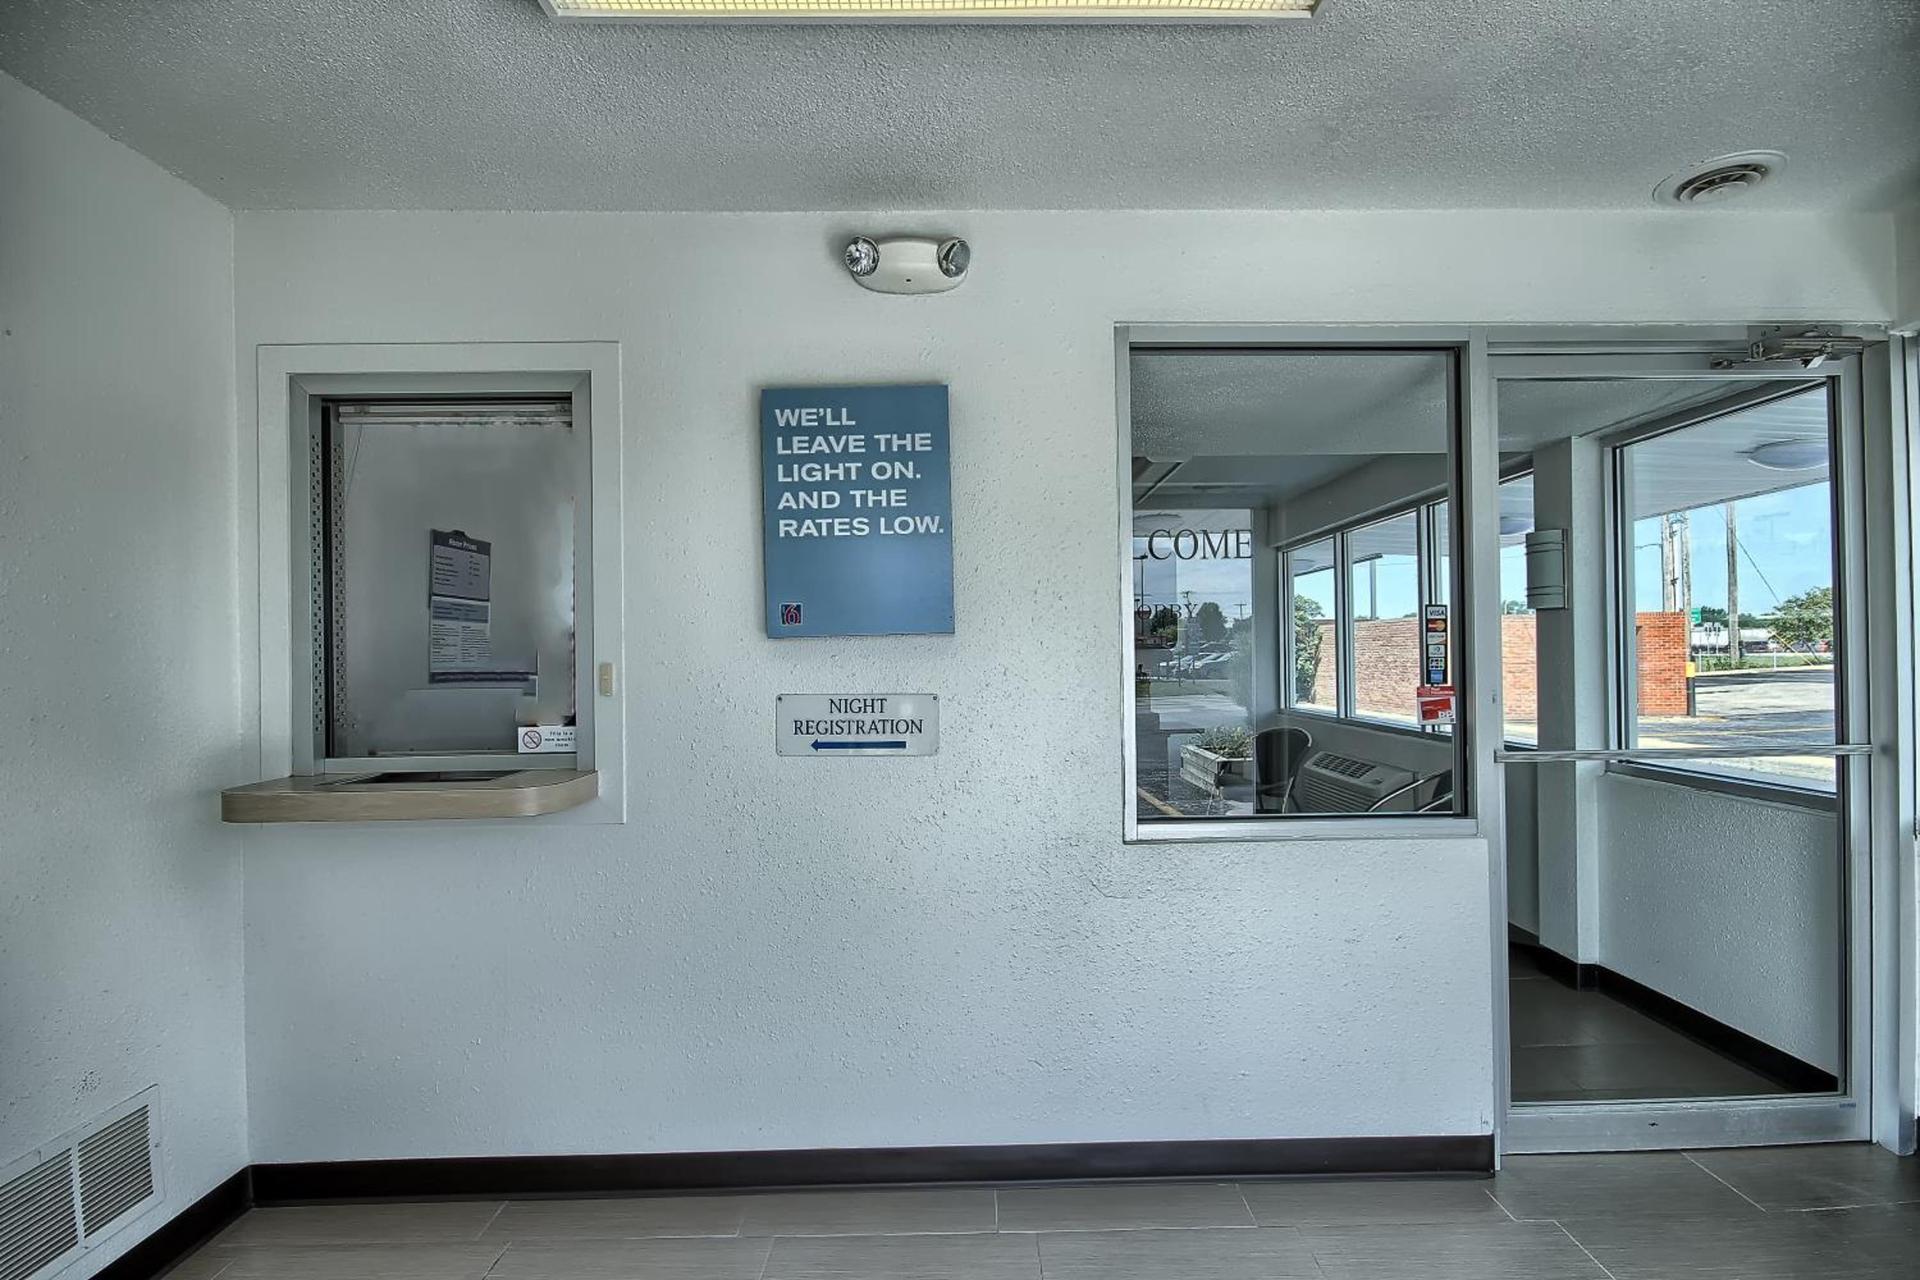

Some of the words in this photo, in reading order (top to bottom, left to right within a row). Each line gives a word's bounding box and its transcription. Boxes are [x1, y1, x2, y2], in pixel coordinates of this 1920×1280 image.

[775, 408, 856, 426] WE'LL
[777, 435, 865, 454] LEAVE
[874, 433, 932, 452] THE
[778, 463, 862, 482] LIGHT
[871, 462, 921, 480] ON.
[778, 491, 840, 509] AND
[850, 489, 907, 508] THE
[779, 518, 869, 537] RATES
[880, 516, 944, 535] LOW.
[1133, 529, 1253, 560] COME
[1134, 603, 1198, 619] OBBY
[829, 698, 887, 713] NIGHT
[793, 719, 923, 735] REGISTRATION
